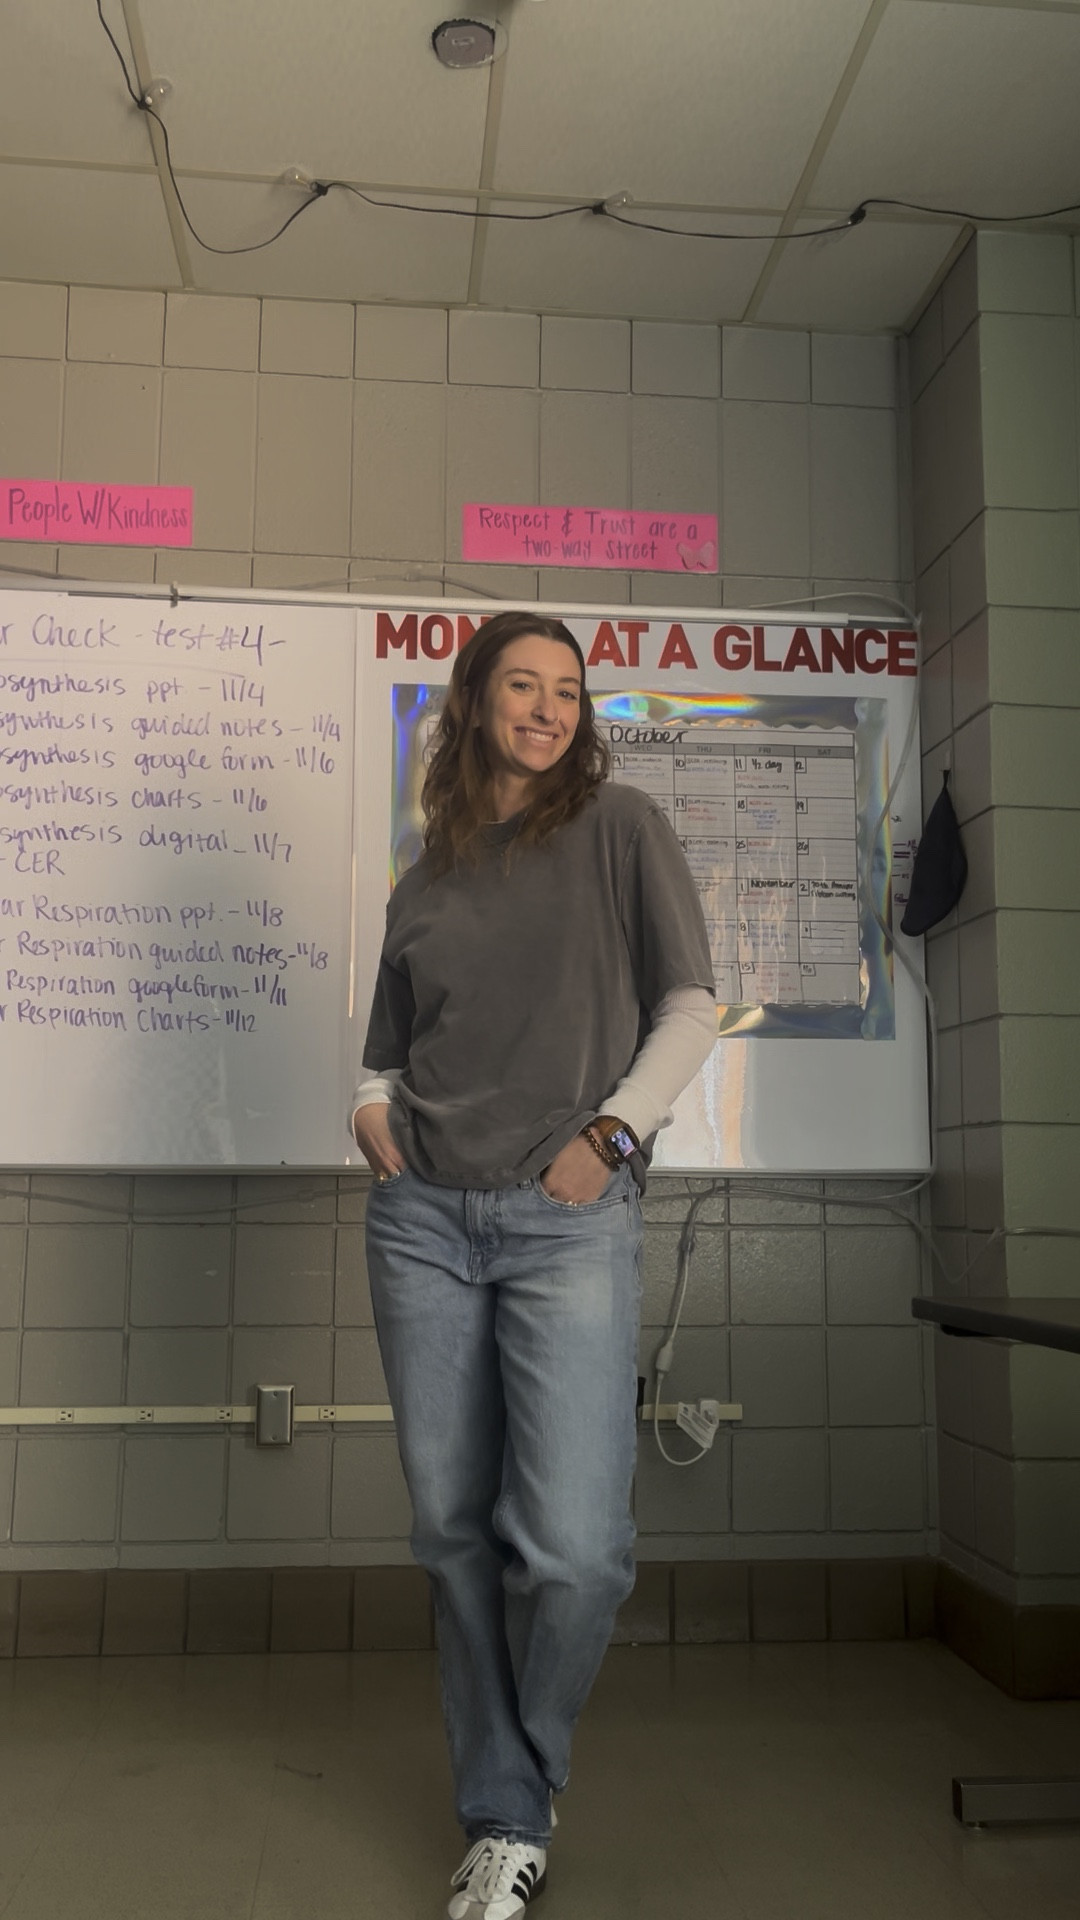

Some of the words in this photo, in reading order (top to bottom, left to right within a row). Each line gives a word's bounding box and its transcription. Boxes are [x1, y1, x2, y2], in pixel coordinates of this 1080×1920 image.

[9, 485, 72, 535] People
[479, 507, 550, 536] Respect
[584, 511, 636, 536] Trust
[648, 519, 677, 539] are
[687, 523, 697, 540] a
[522, 535, 591, 561] two-way
[32, 613, 120, 648] Check
[376, 613, 563, 660] MON
[587, 621, 649, 668] AT
[658, 624, 698, 669] A
[713, 625, 918, 676] GLANCE
[147, 677, 184, 703] ppt
[131, 712, 210, 740] guided
[220, 718, 283, 737] notes
[610, 725, 688, 744] October
[696, 745, 713, 753] THU
[817, 748, 832, 756] SAT
[134, 749, 211, 779] google
[221, 746, 274, 770] form
[675, 758, 686, 769] 10
[735, 758, 743, 770] 11
[764, 759, 783, 774] day
[139, 824, 228, 855] digital
[254, 832, 292, 863] 11/7
[15, 849, 66, 875] CER
[750, 879, 796, 889] November
[800, 883, 808, 893] 2
[32, 895, 172, 928] Respiration
[740, 922, 747, 933] 8
[17, 930, 143, 962] Respiration
[149, 940, 225, 970] guided
[741, 963, 752, 972] 15
[7, 968, 115, 997] Respiration
[17, 999, 127, 1031] Respiration
